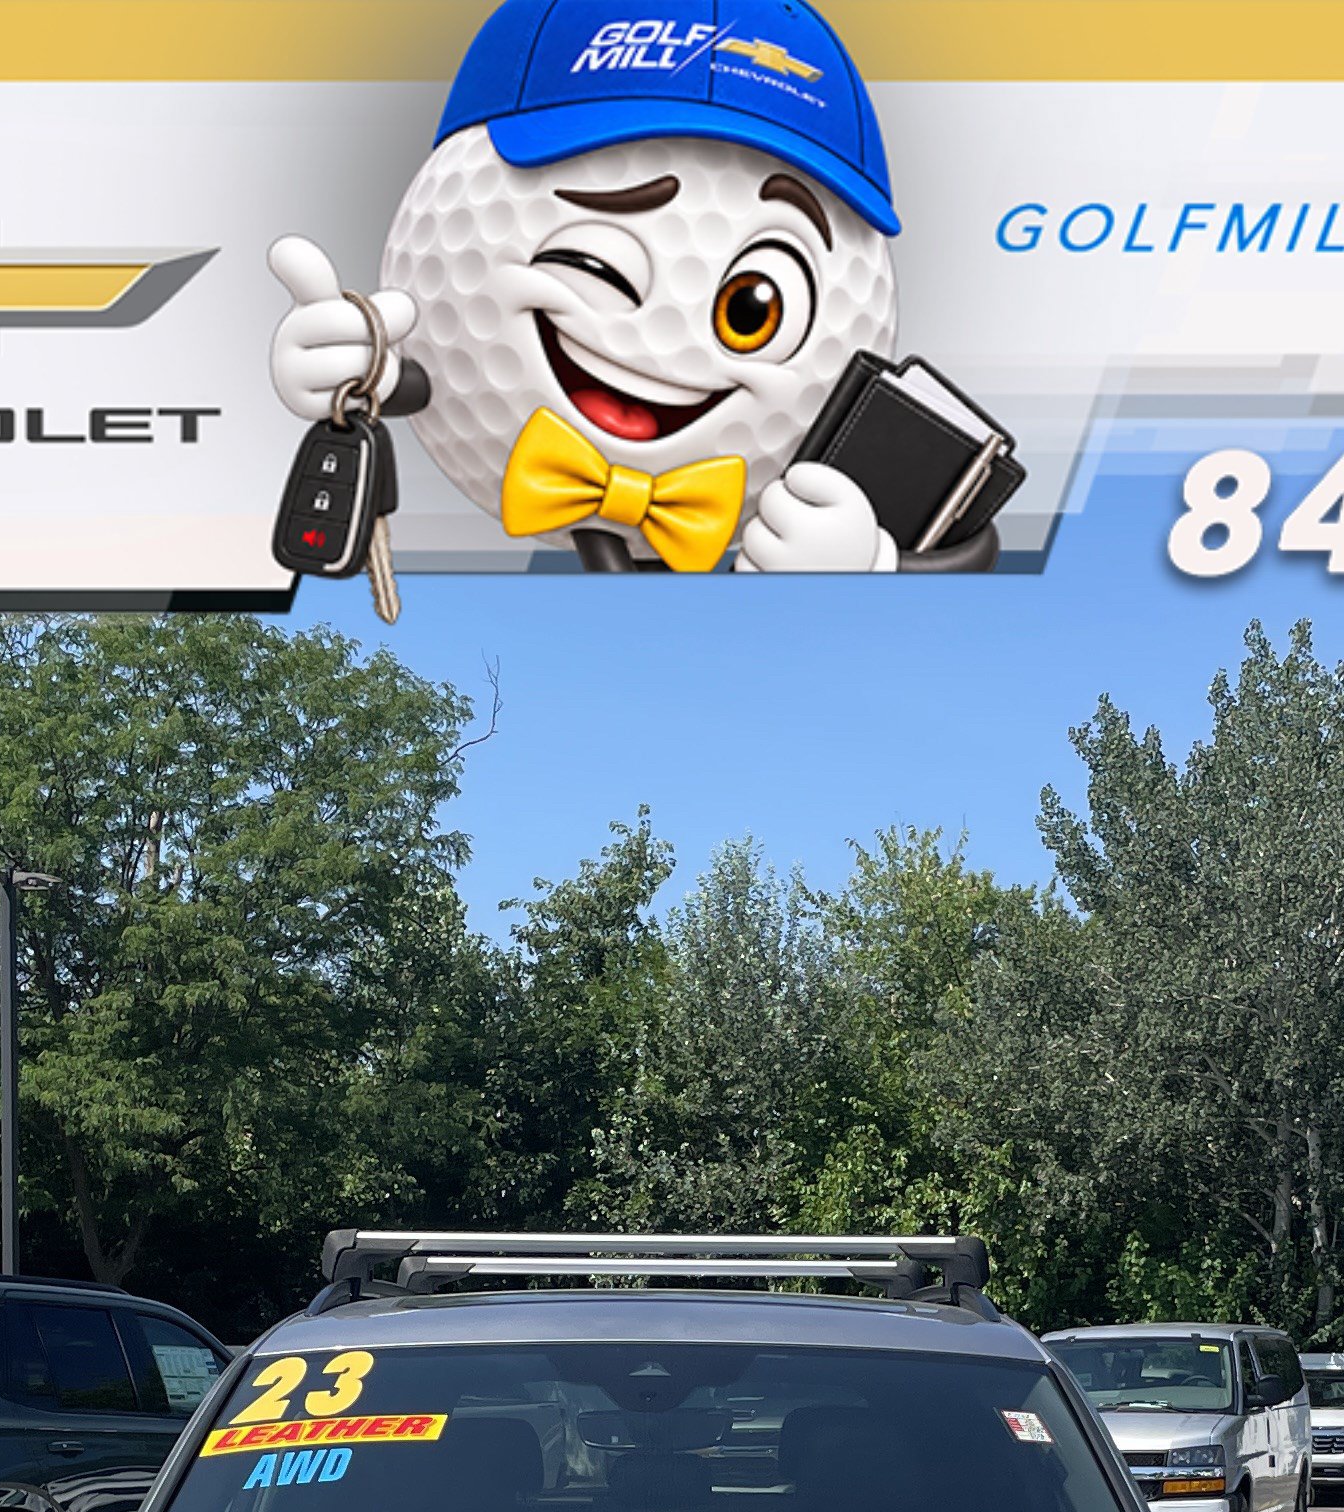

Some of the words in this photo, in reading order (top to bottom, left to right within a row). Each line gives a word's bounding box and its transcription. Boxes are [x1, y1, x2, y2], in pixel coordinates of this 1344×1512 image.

[228, 1350, 374, 1425] 23
[211, 1415, 436, 1450] LEATHER
[242, 1447, 353, 1490] AWD
